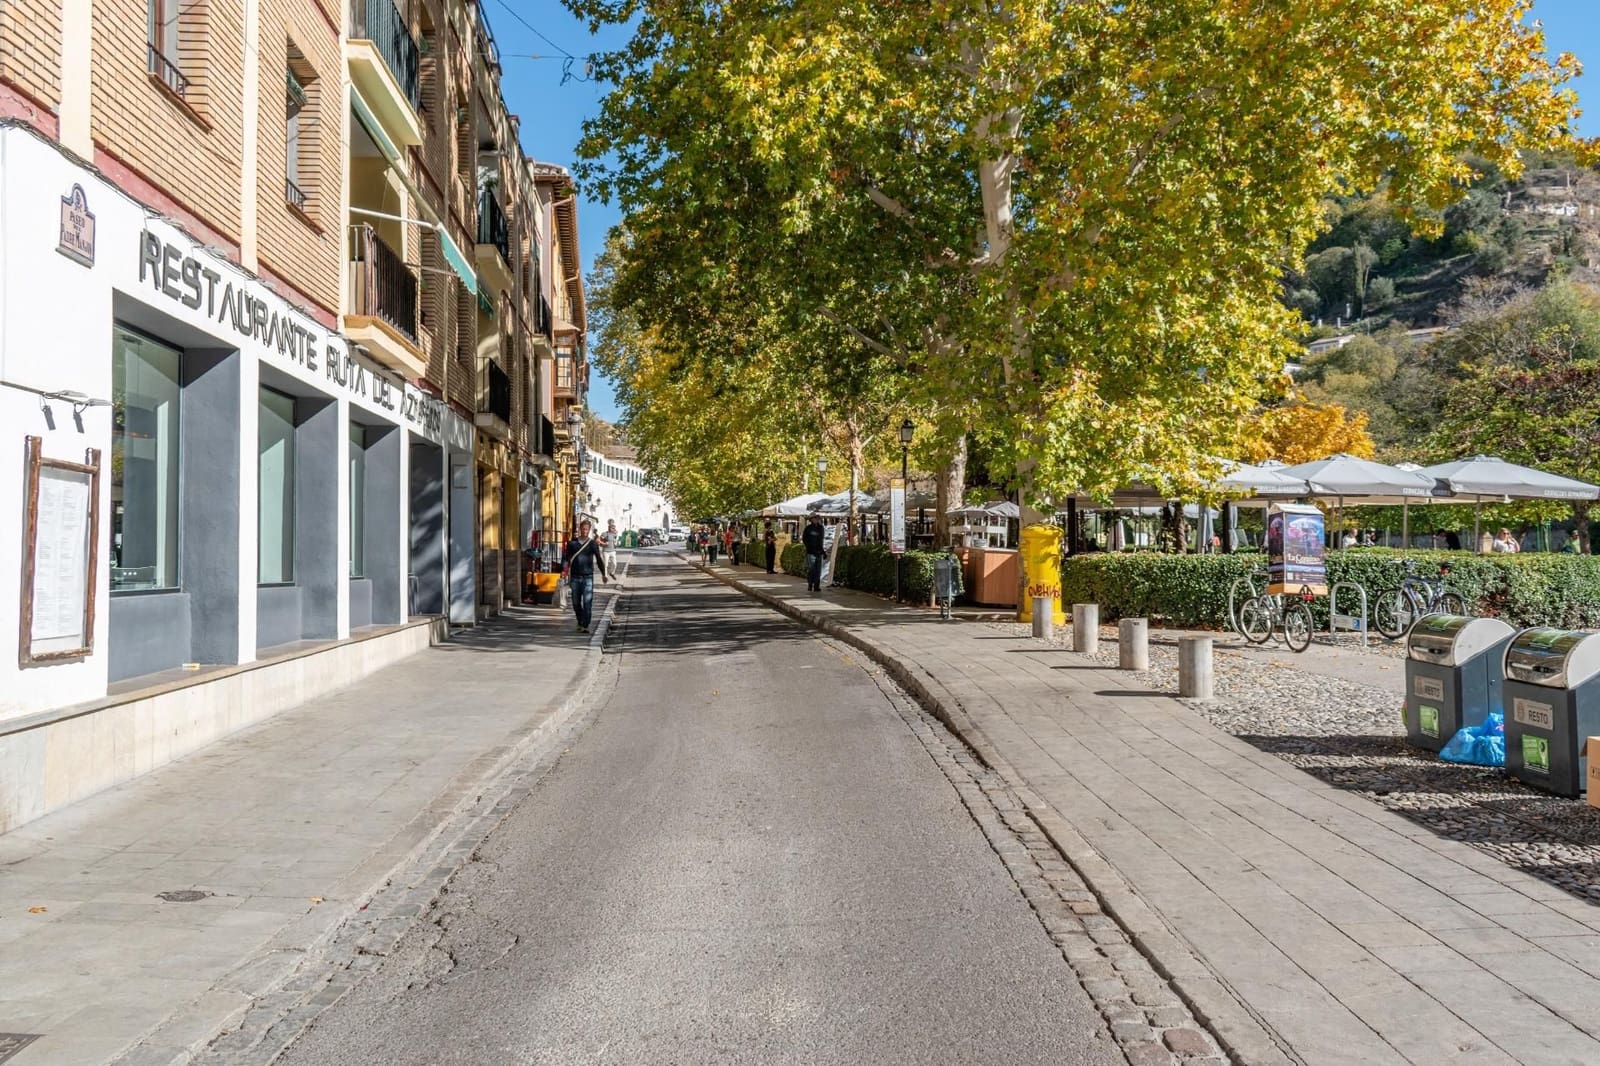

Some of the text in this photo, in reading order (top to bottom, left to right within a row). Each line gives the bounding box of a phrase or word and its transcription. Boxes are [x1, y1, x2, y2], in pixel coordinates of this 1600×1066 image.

[139, 228, 318, 372] RESTAURANTE
[326, 344, 366, 398] RUTA
[373, 372, 395, 411] DEL
[1528, 709, 1549, 725] RESTO
